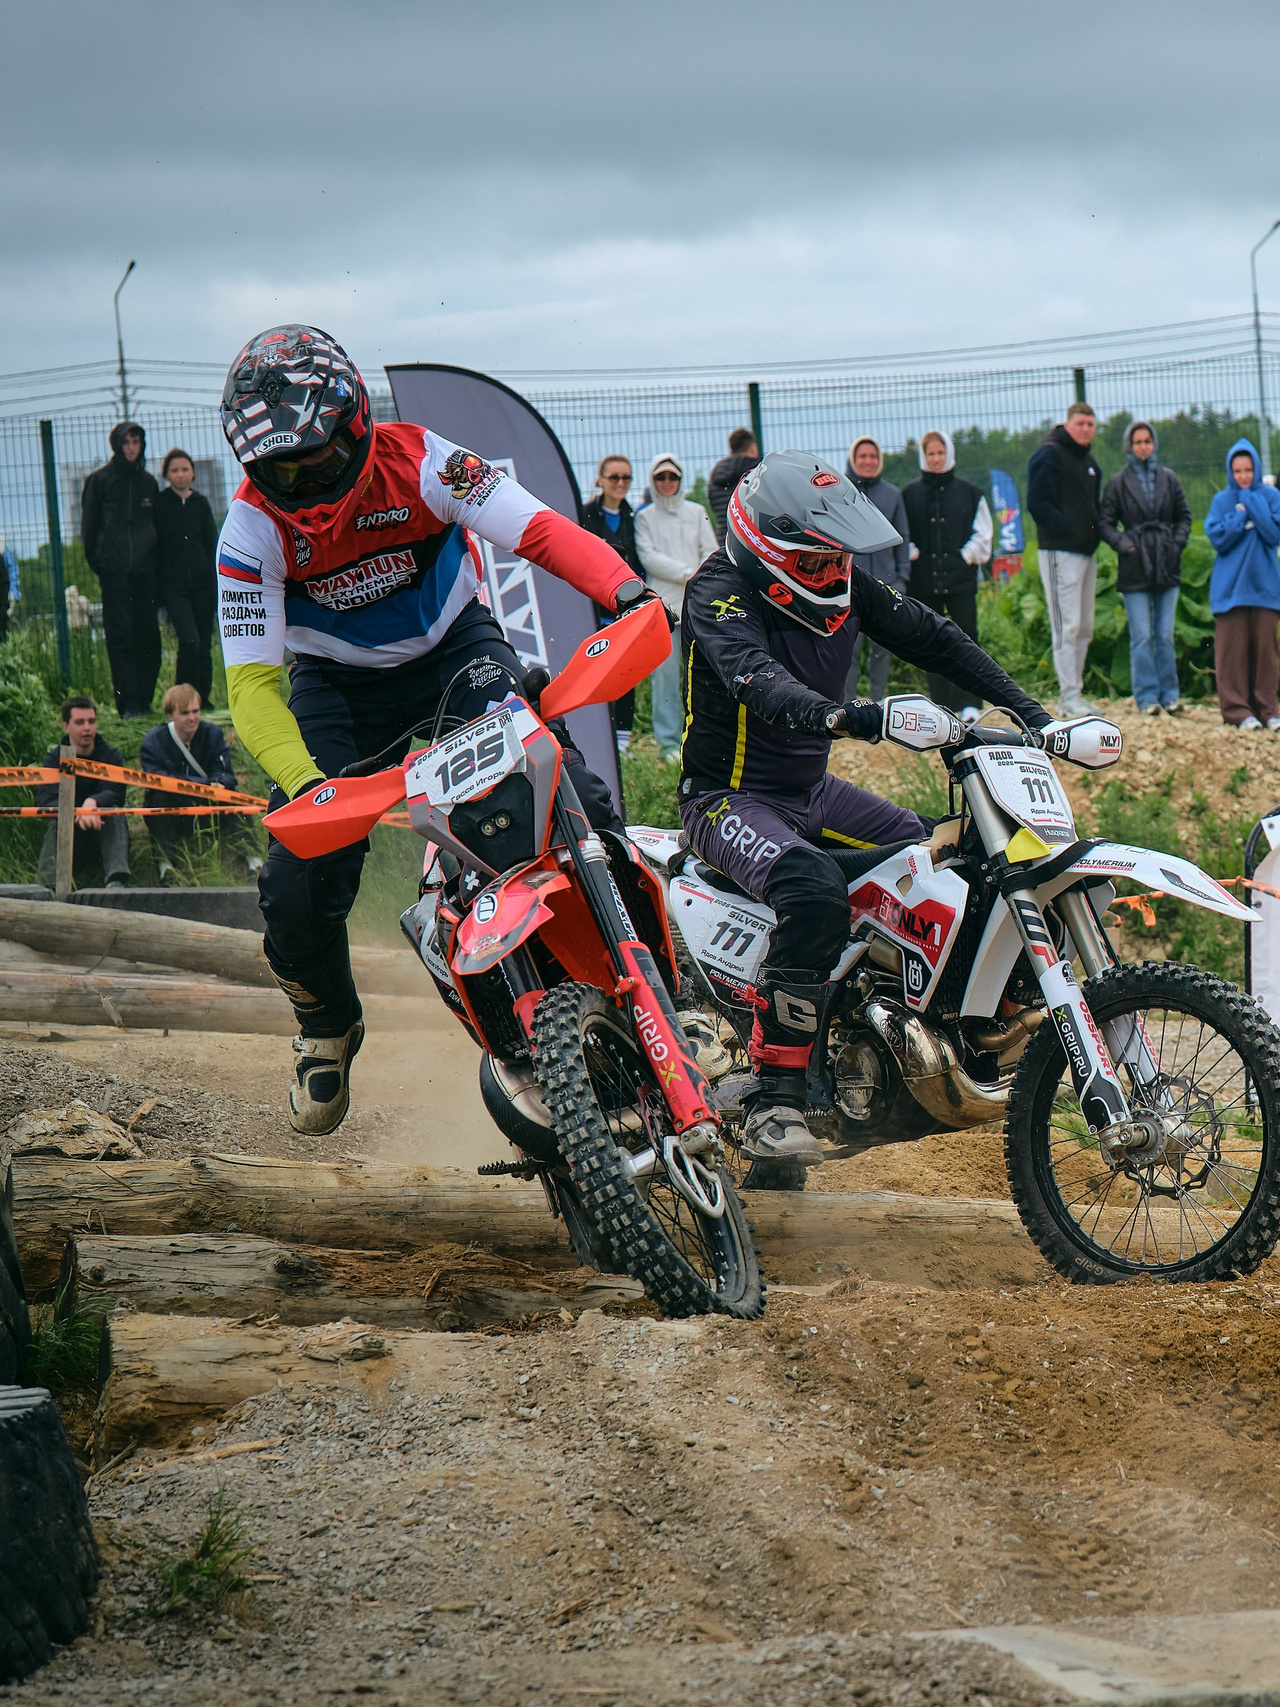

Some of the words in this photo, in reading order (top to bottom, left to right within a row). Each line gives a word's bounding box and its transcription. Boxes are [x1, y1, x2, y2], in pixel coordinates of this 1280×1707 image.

[262, 434, 294, 451] SHOEI
[307, 550, 416, 595] MAYTUN
[222, 590, 263, 604] КОМИТЕТ
[222, 606, 266, 621] РАЗДАЧИ
[223, 624, 265, 638] СОВЕТОВ
[434, 731, 504, 795] 125
[988, 751, 1014, 760] ЯДОВ
[475, 771, 505, 787] Игорь
[1021, 777, 1055, 805] 111
[710, 921, 757, 957] 111
[891, 903, 942, 946] ONLY1
[633, 1005, 682, 1088] X-GRIP
[1054, 1007, 1089, 1078] X-GRIP.RU
[1079, 1001, 1115, 1078] OSSPORT
